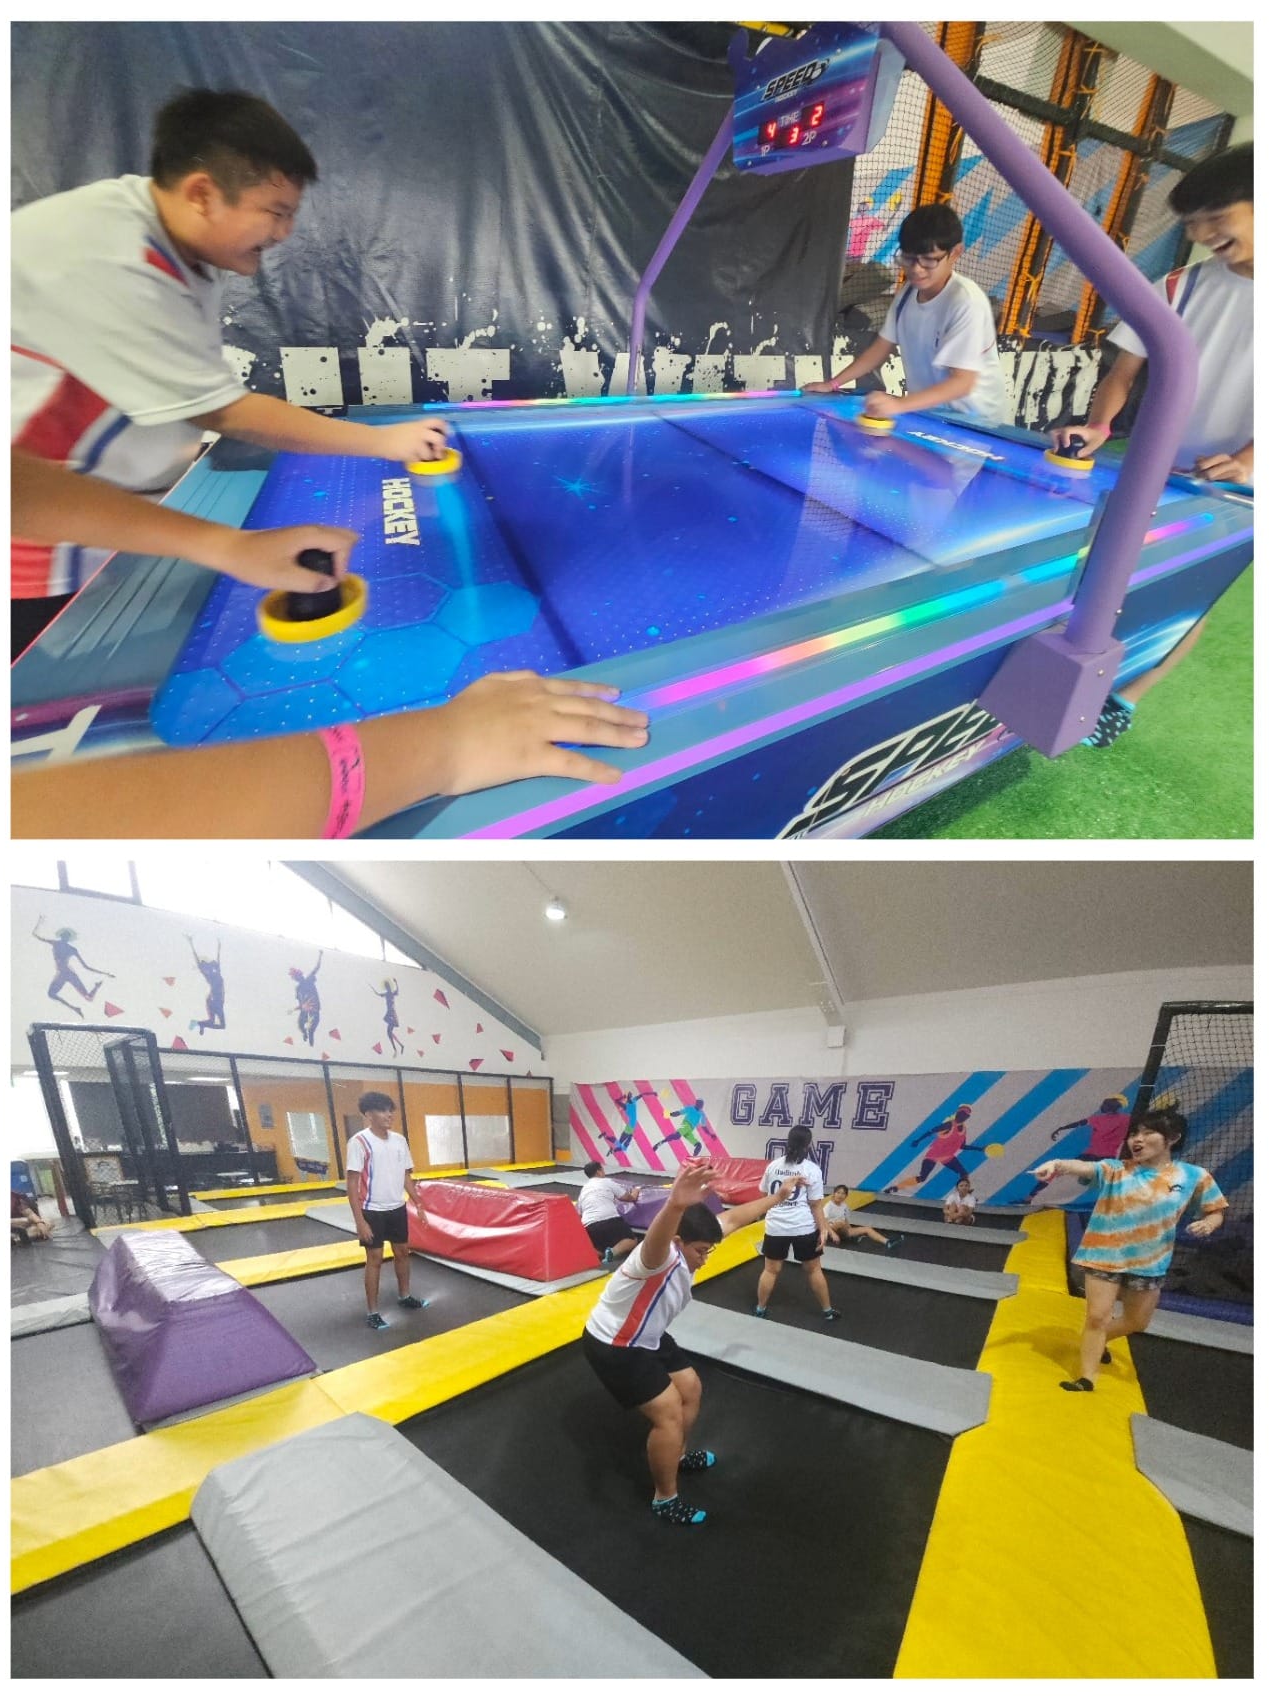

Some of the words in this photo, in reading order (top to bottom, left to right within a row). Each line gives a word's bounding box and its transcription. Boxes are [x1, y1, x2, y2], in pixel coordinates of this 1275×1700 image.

[761, 59, 823, 103] SPEED
[780, 110, 800, 127] TIME
[810, 105, 823, 126] 2
[767, 122, 776, 138] 4
[789, 126, 800, 145] 3
[381, 477, 421, 546] HOCKEY
[730, 1081, 895, 1130] GAME
